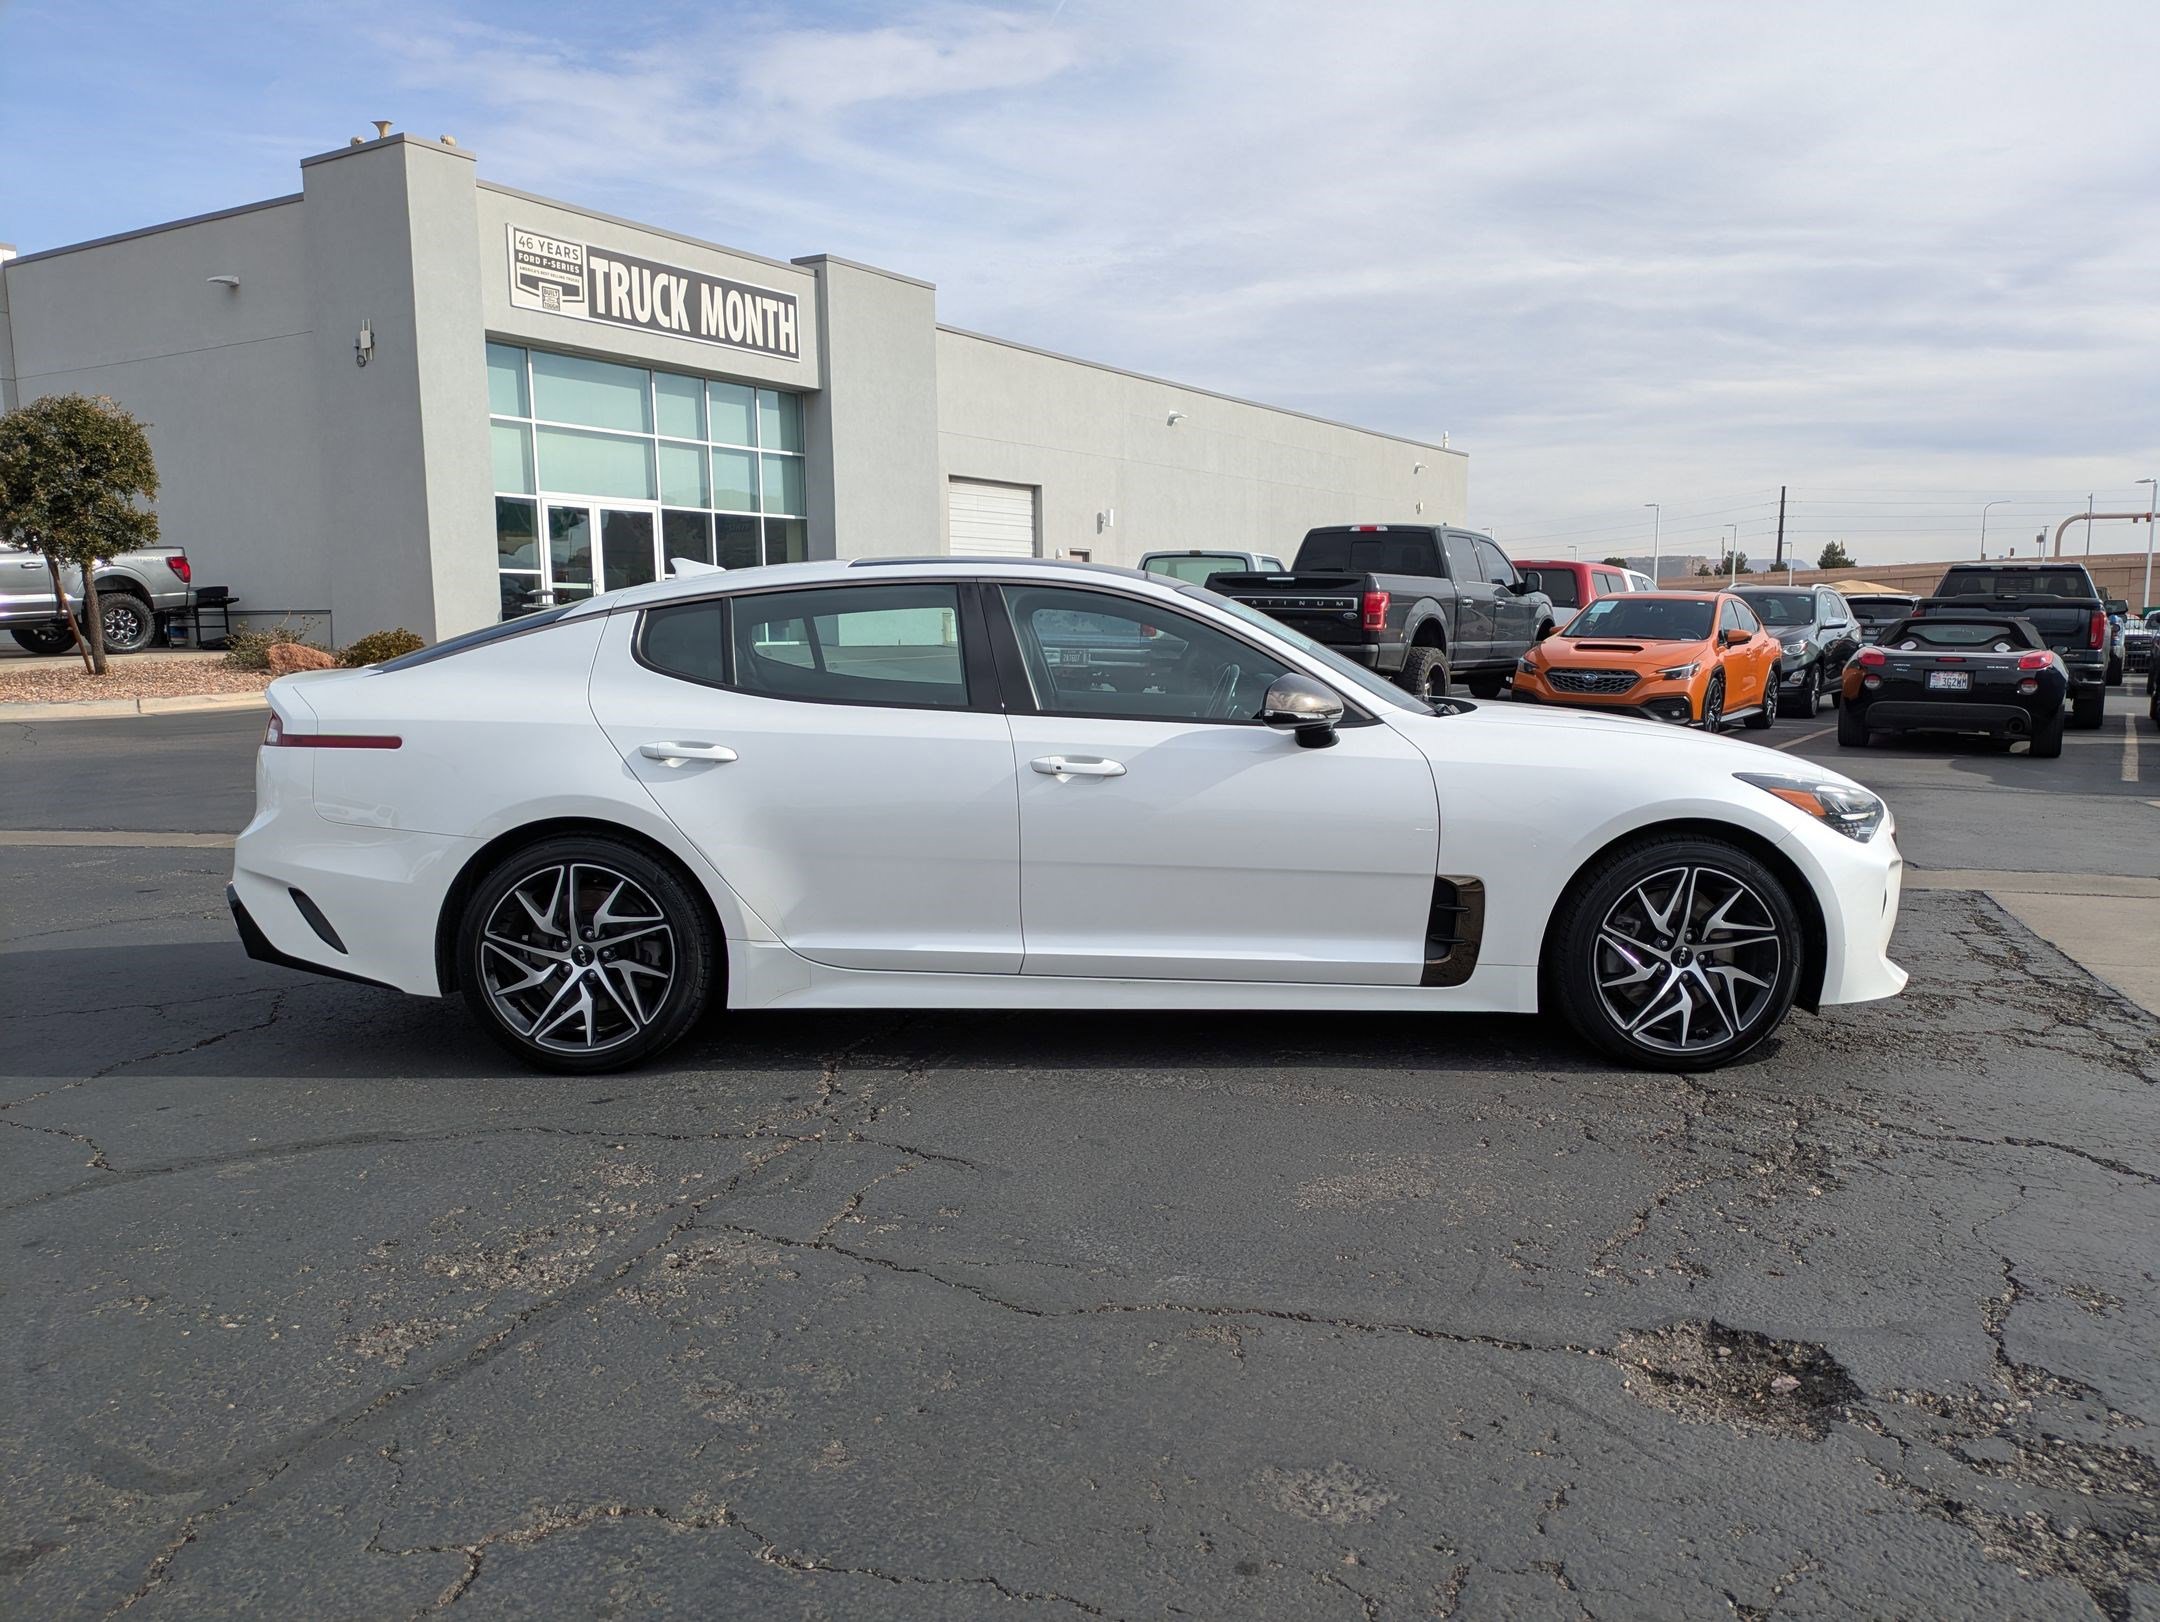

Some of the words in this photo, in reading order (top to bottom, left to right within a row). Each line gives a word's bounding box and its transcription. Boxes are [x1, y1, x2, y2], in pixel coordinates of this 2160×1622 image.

[518, 236, 534, 250] 46
[538, 240, 579, 260] YEARS
[518, 252, 541, 264] FORD
[543, 258, 580, 274] F-SERIES
[543, 288, 558, 297] BUILT
[589, 255, 690, 332] TRUCK
[701, 283, 796, 353] MONTH
